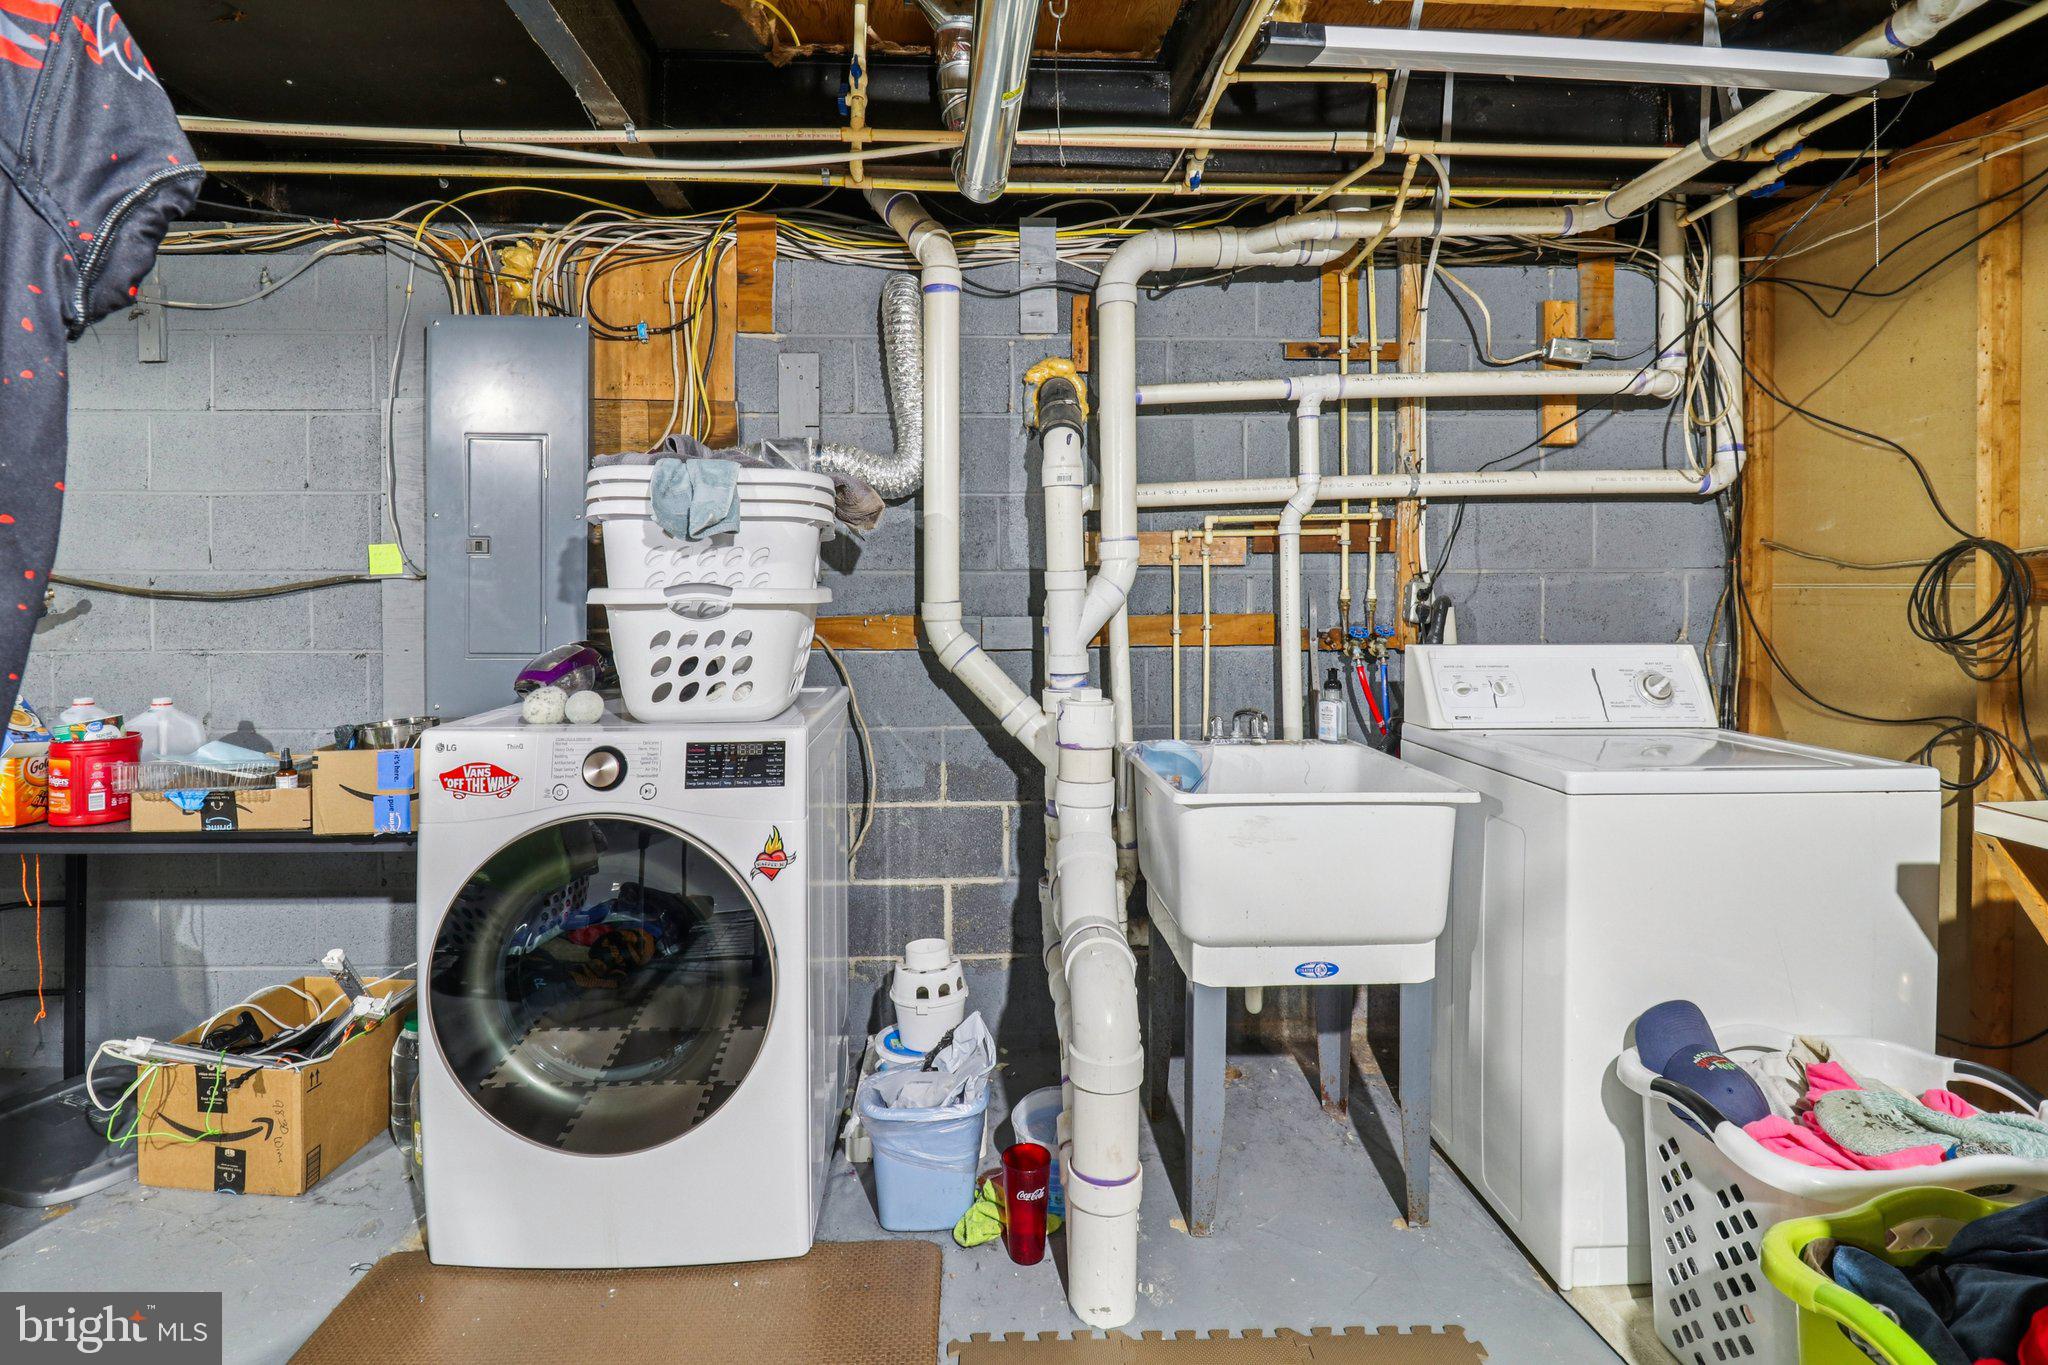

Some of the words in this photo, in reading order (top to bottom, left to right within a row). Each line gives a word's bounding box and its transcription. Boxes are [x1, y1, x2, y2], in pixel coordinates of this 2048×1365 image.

[463, 765, 491, 777] VANS
[466, 777, 486, 792] THE
[206, 822, 233, 830] prime
